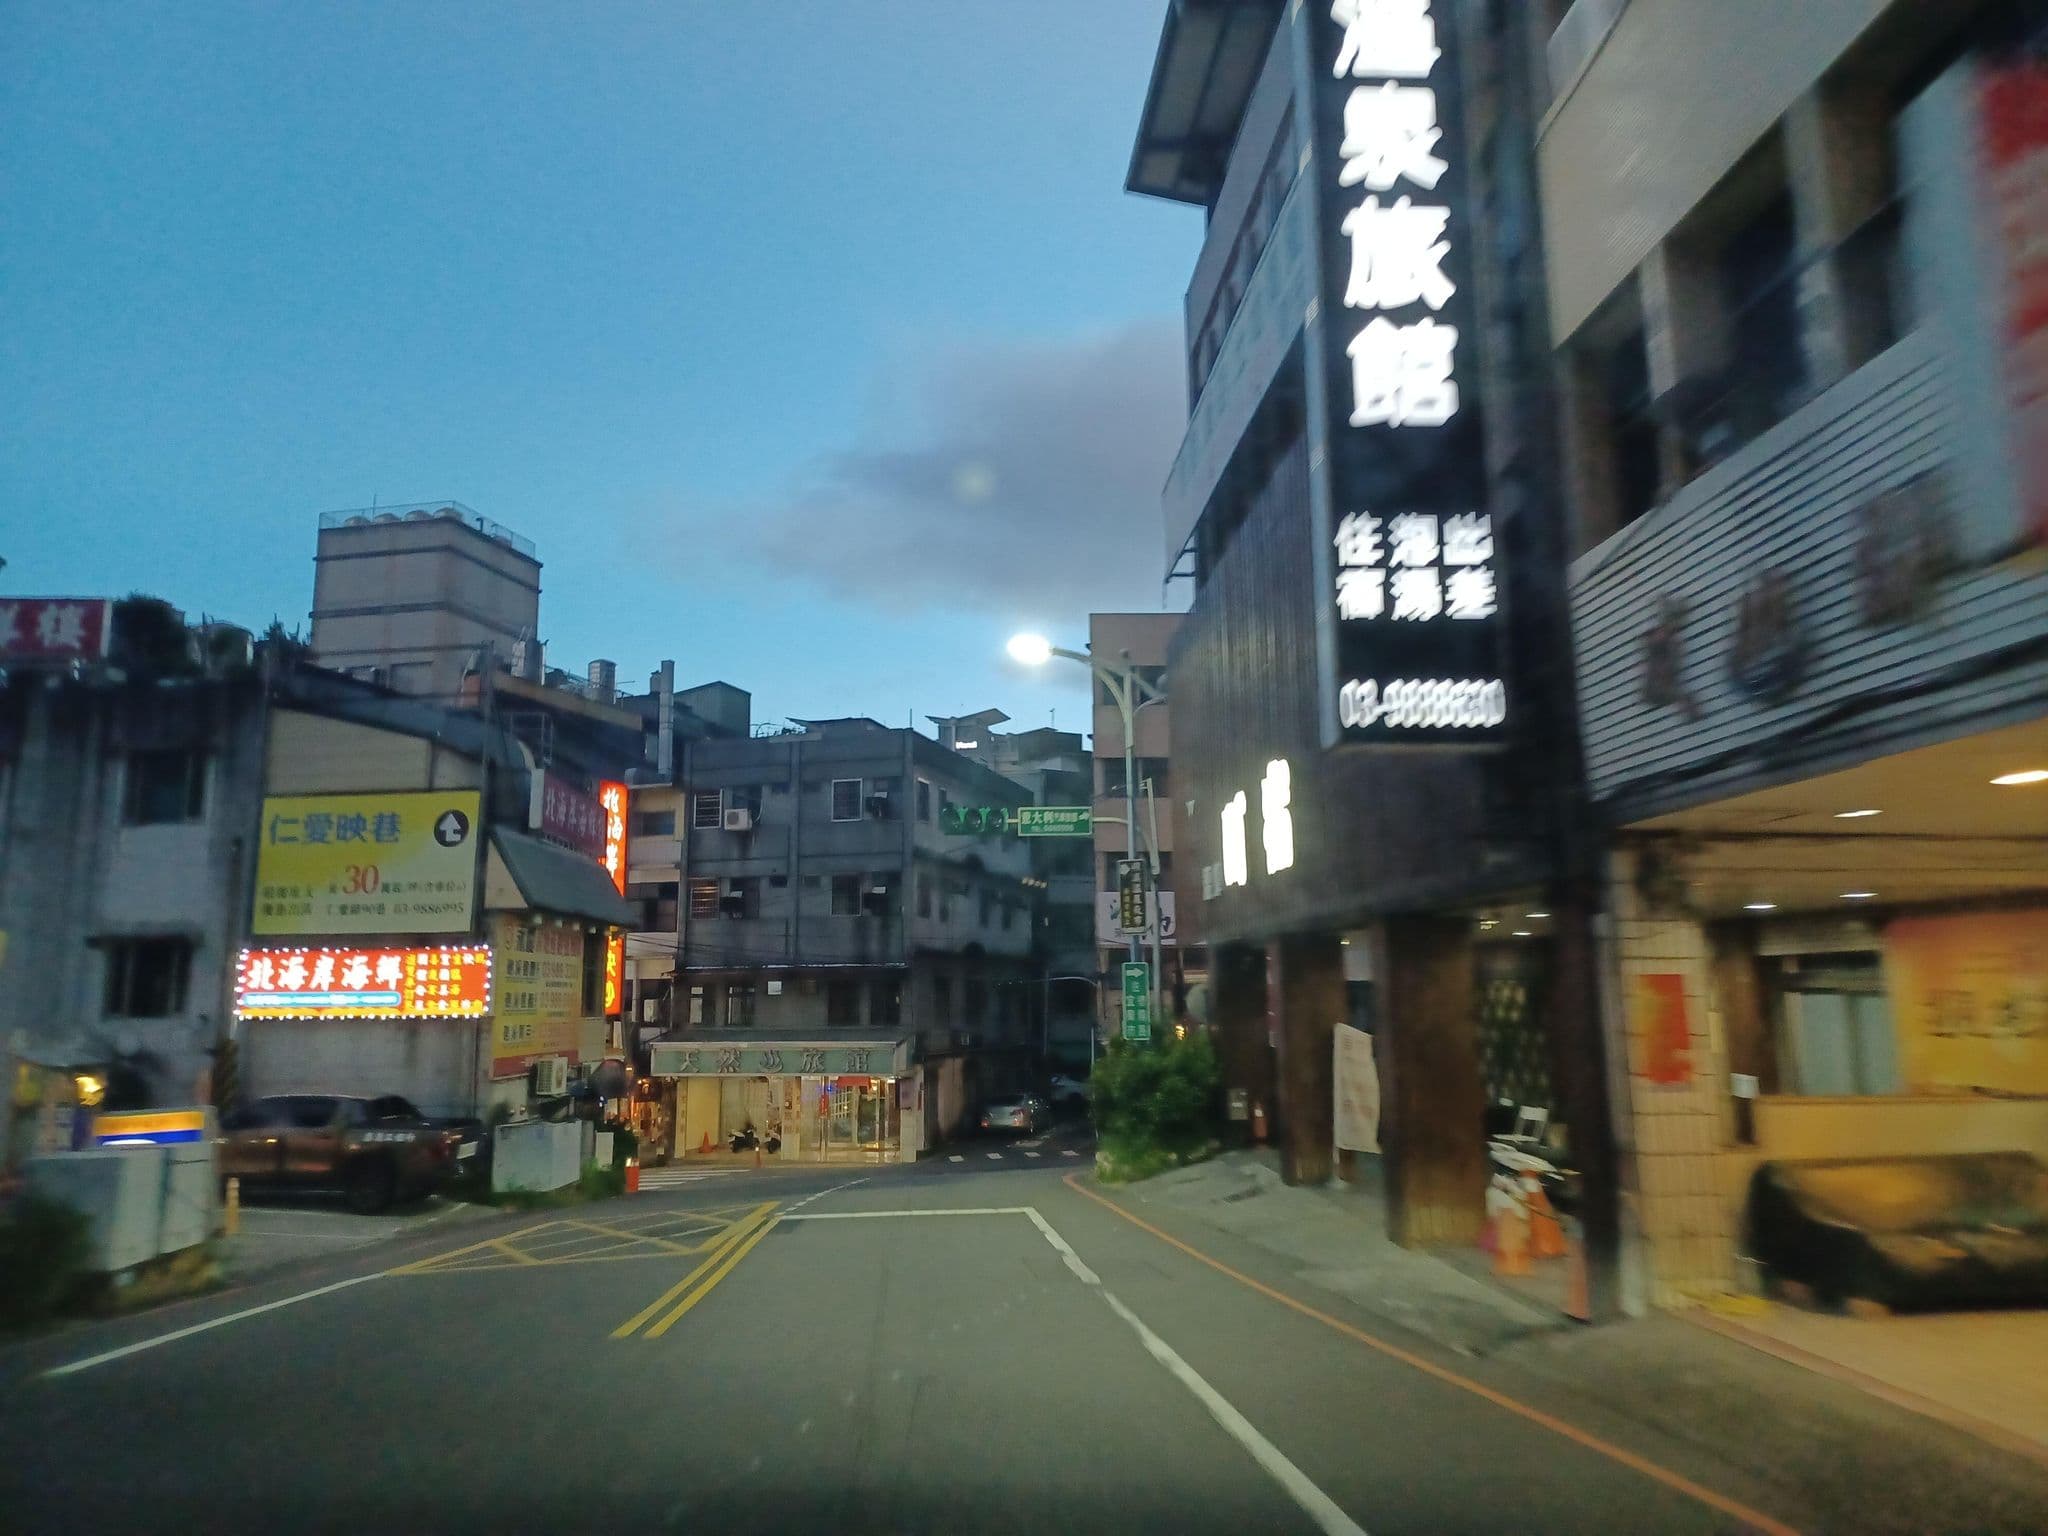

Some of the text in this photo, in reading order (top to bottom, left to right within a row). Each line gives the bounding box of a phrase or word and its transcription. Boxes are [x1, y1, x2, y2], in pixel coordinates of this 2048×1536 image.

[270, 812, 401, 845] 仁愛映巷
[342, 864, 379, 895] 30
